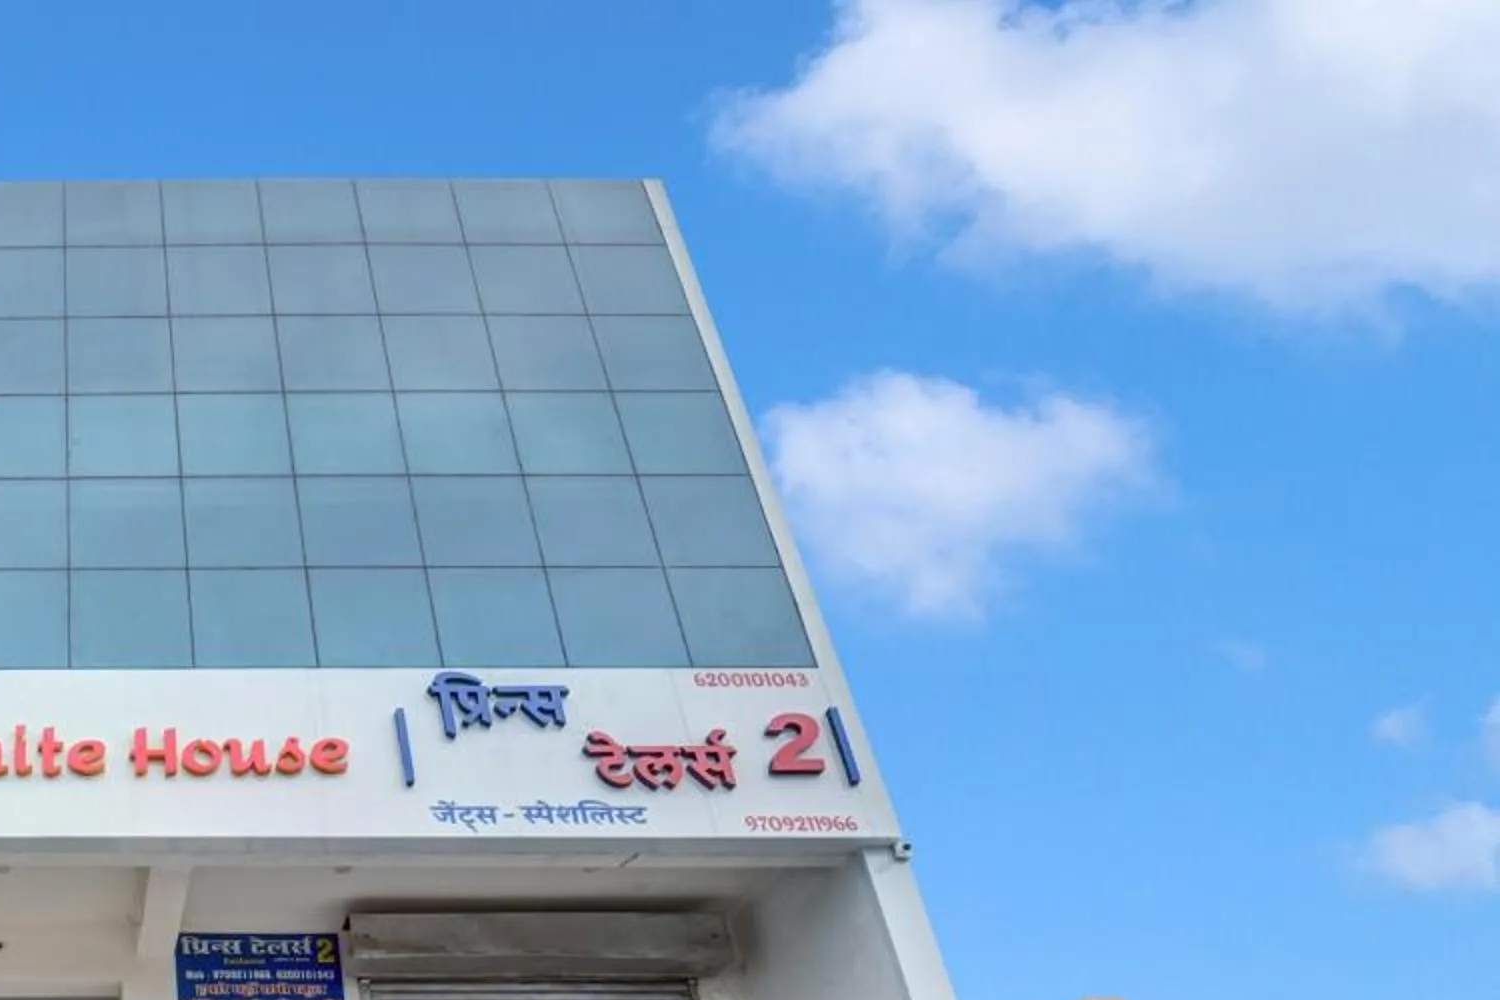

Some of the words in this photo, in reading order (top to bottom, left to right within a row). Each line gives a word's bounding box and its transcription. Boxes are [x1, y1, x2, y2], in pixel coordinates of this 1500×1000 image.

[694, 672, 809, 688] 6200101043
[427, 672, 569, 739] प्रिन्स
[129, 727, 350, 779] House
[582, 729, 737, 791] टेलर्स
[764, 712, 825, 775] 2
[521, 800, 649, 825] स्पेशलिस्ट
[744, 815, 858, 832] 9709211966
[316, 938, 335, 963] 2
